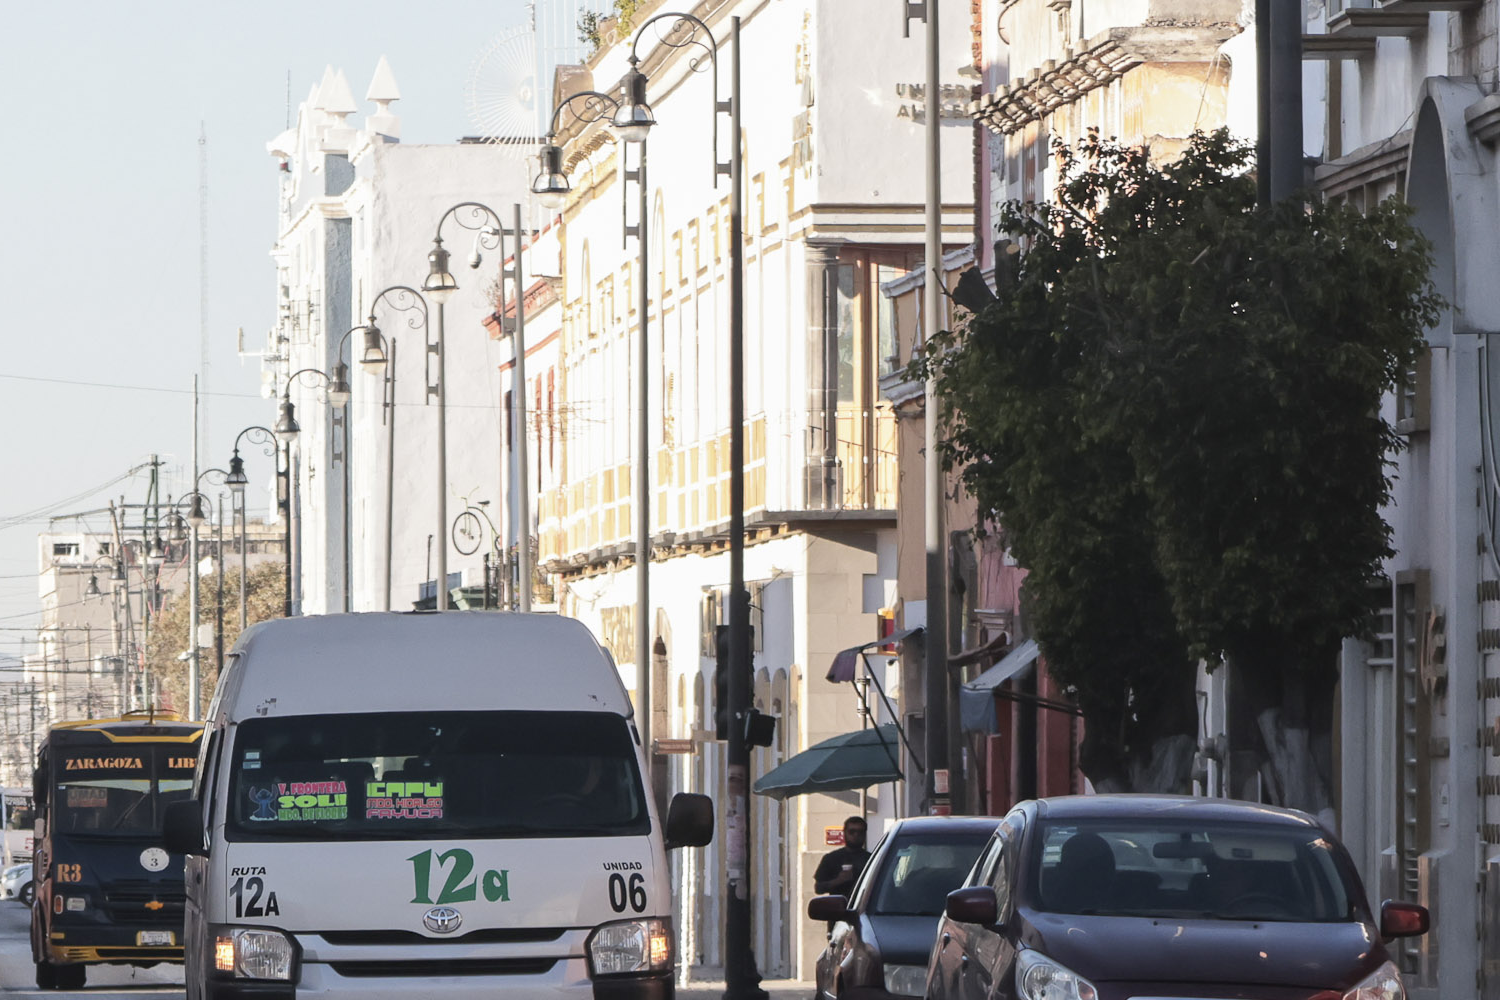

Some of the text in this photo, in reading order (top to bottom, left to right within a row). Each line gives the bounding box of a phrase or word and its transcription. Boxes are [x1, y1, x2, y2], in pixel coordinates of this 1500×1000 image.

[65, 757, 197, 770] ZARAGOZA LIB
[290, 781, 347, 795] FRONTERA
[396, 798, 443, 809] HIDALGO
[366, 809, 443, 819] FAYUCA
[150, 857, 159, 867] 3
[603, 861, 643, 871] UNIDAD
[57, 863, 82, 882] R3
[231, 866, 267, 876] RUTA
[405, 848, 511, 905] 12a
[229, 876, 280, 918] 12A
[608, 872, 647, 914] 06
